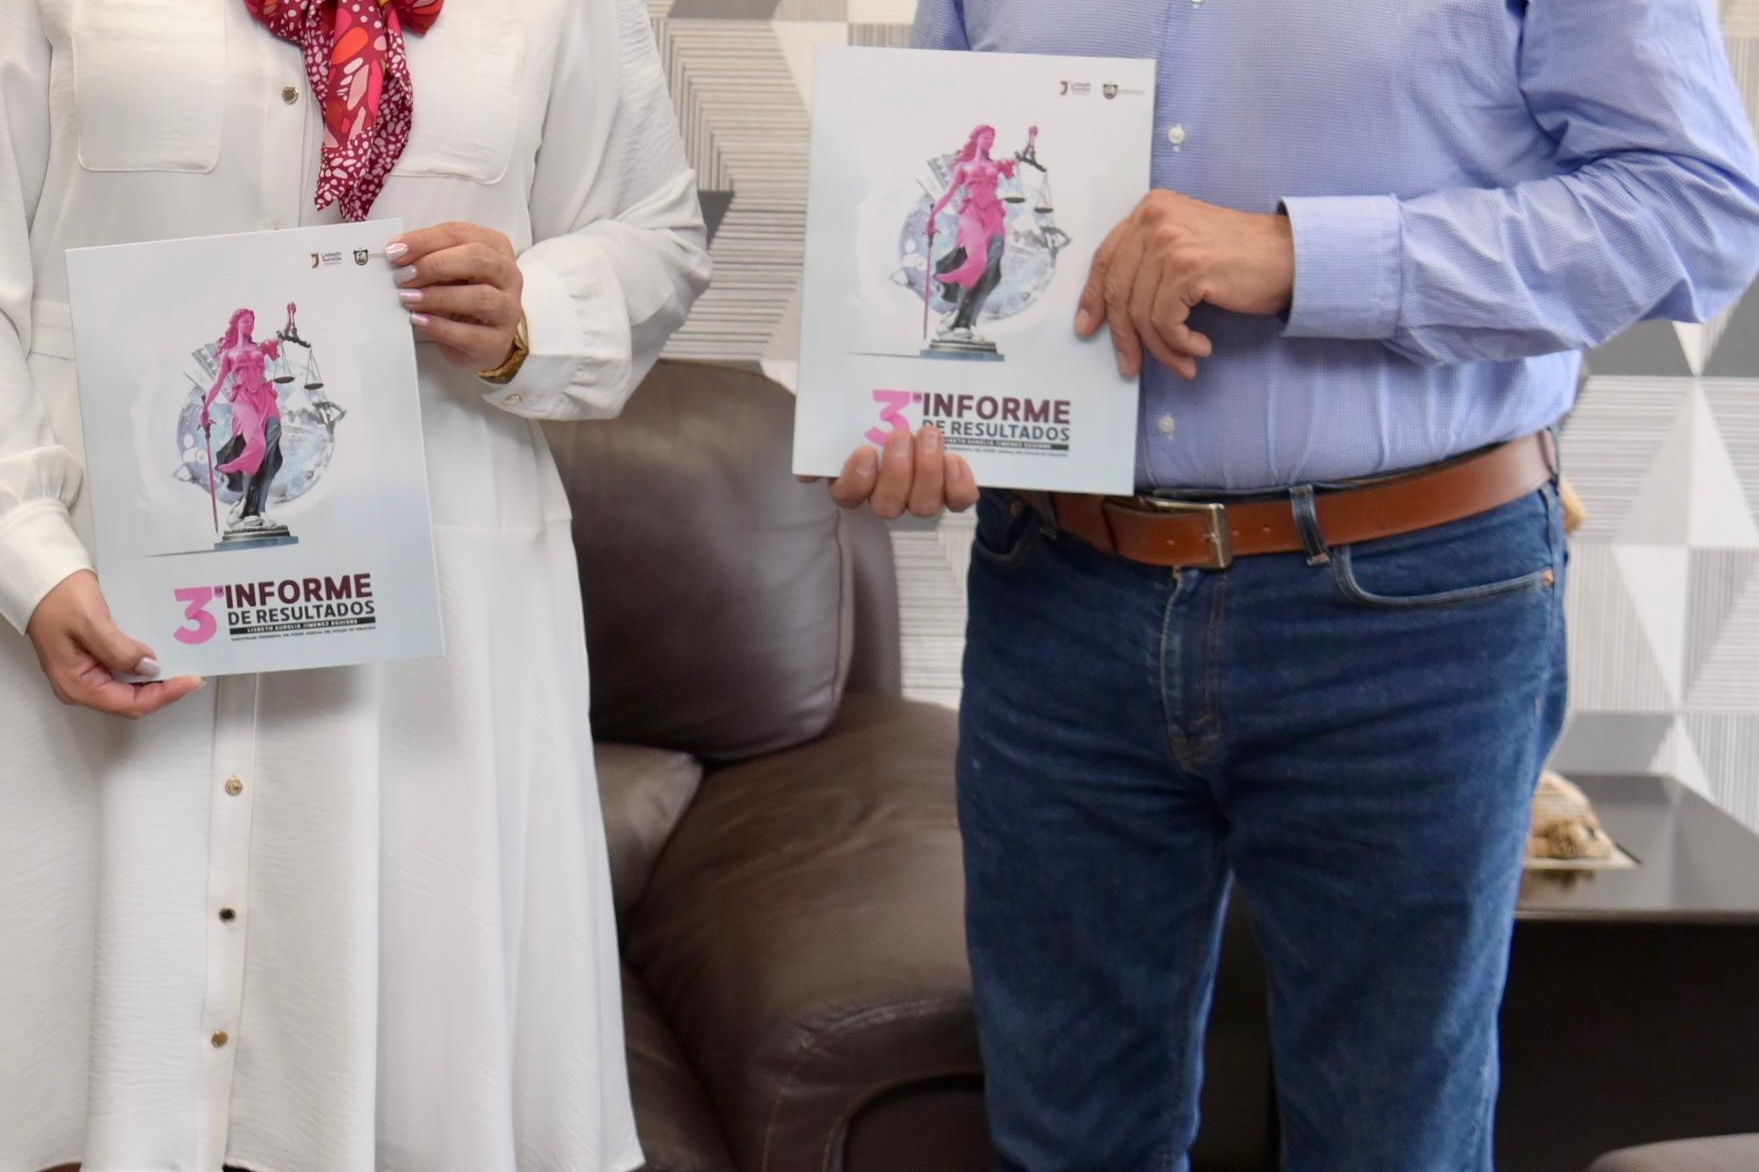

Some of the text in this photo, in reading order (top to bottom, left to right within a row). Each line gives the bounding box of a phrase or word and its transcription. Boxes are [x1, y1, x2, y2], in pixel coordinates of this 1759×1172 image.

[923, 392, 1071, 425] INFORME
[948, 421, 1070, 442] RESULTADOS
[225, 573, 373, 609] INFORME
[228, 600, 375, 626] DE RESULTADOS
